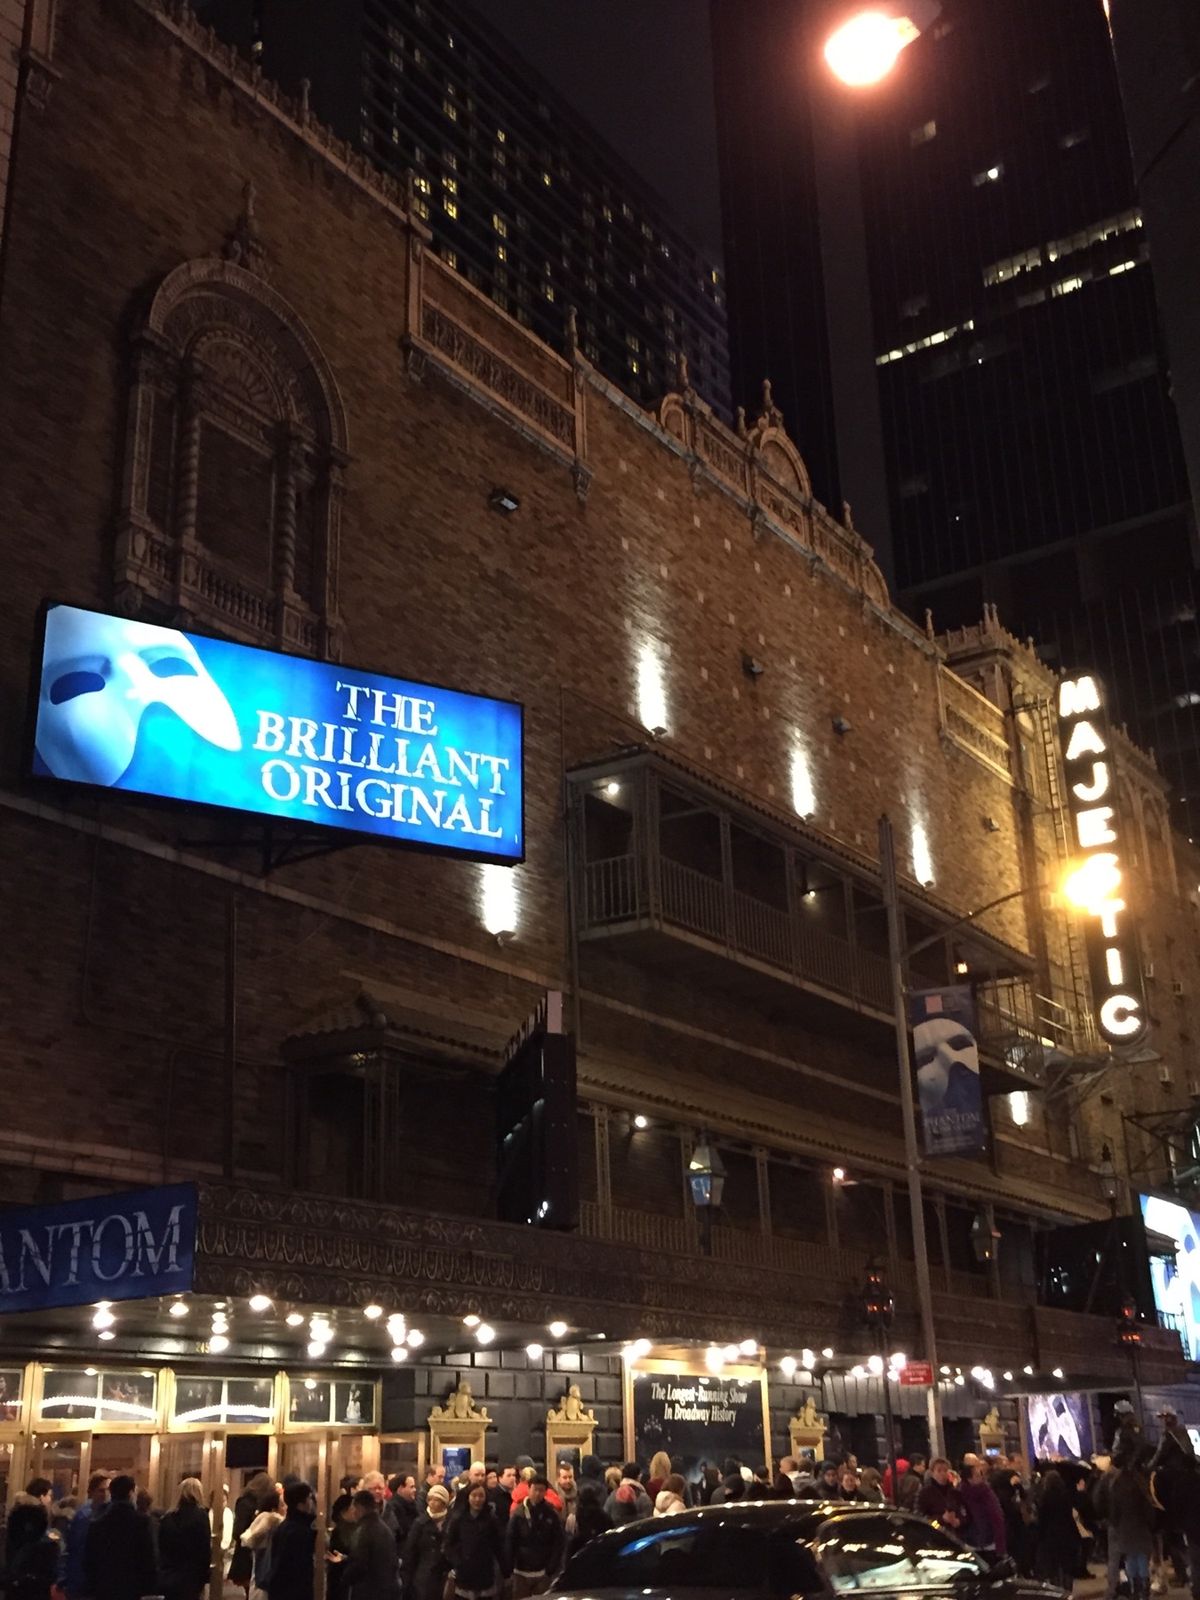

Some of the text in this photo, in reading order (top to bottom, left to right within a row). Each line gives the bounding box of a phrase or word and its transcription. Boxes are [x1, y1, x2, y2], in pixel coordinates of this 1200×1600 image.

[336, 680, 438, 737] THE
[253, 710, 510, 795] BRILLIANT
[261, 757, 503, 838] ORIGINAL
[651, 1382, 666, 1400] The
[729, 1386, 748, 1404] Show
[664, 1402, 737, 1427] In Broadway History
